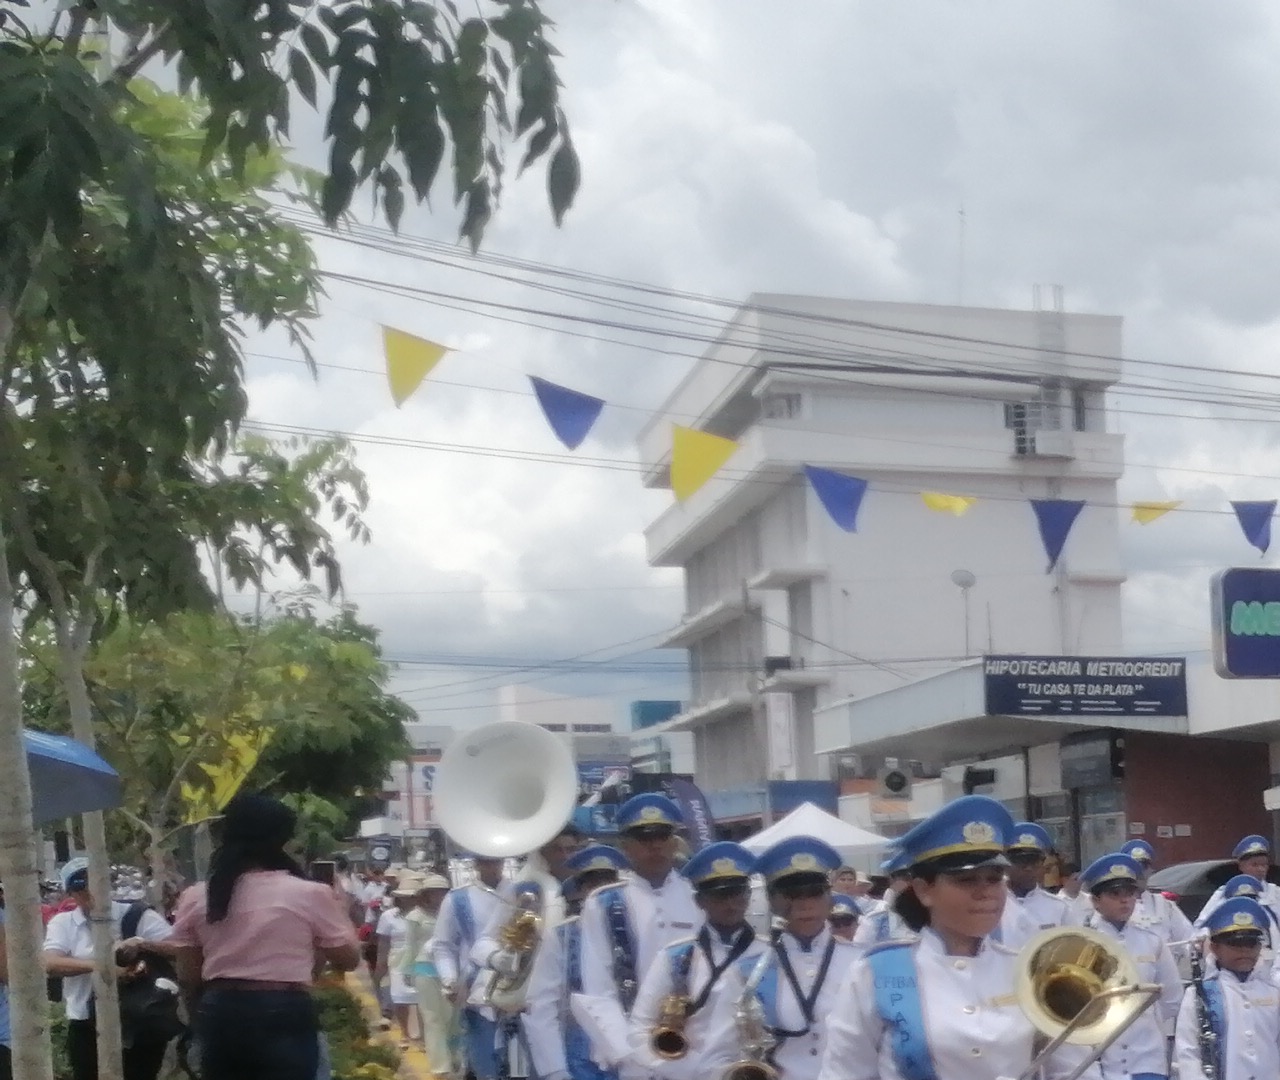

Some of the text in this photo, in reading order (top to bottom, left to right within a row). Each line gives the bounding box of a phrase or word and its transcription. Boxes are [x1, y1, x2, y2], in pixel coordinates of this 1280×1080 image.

[985, 660, 1182, 677] HIPOTECARIA METROCREDIT
[1043, 683, 1072, 696] CASA
[1073, 684, 1086, 696] TE
[1087, 684, 1101, 696] DA
